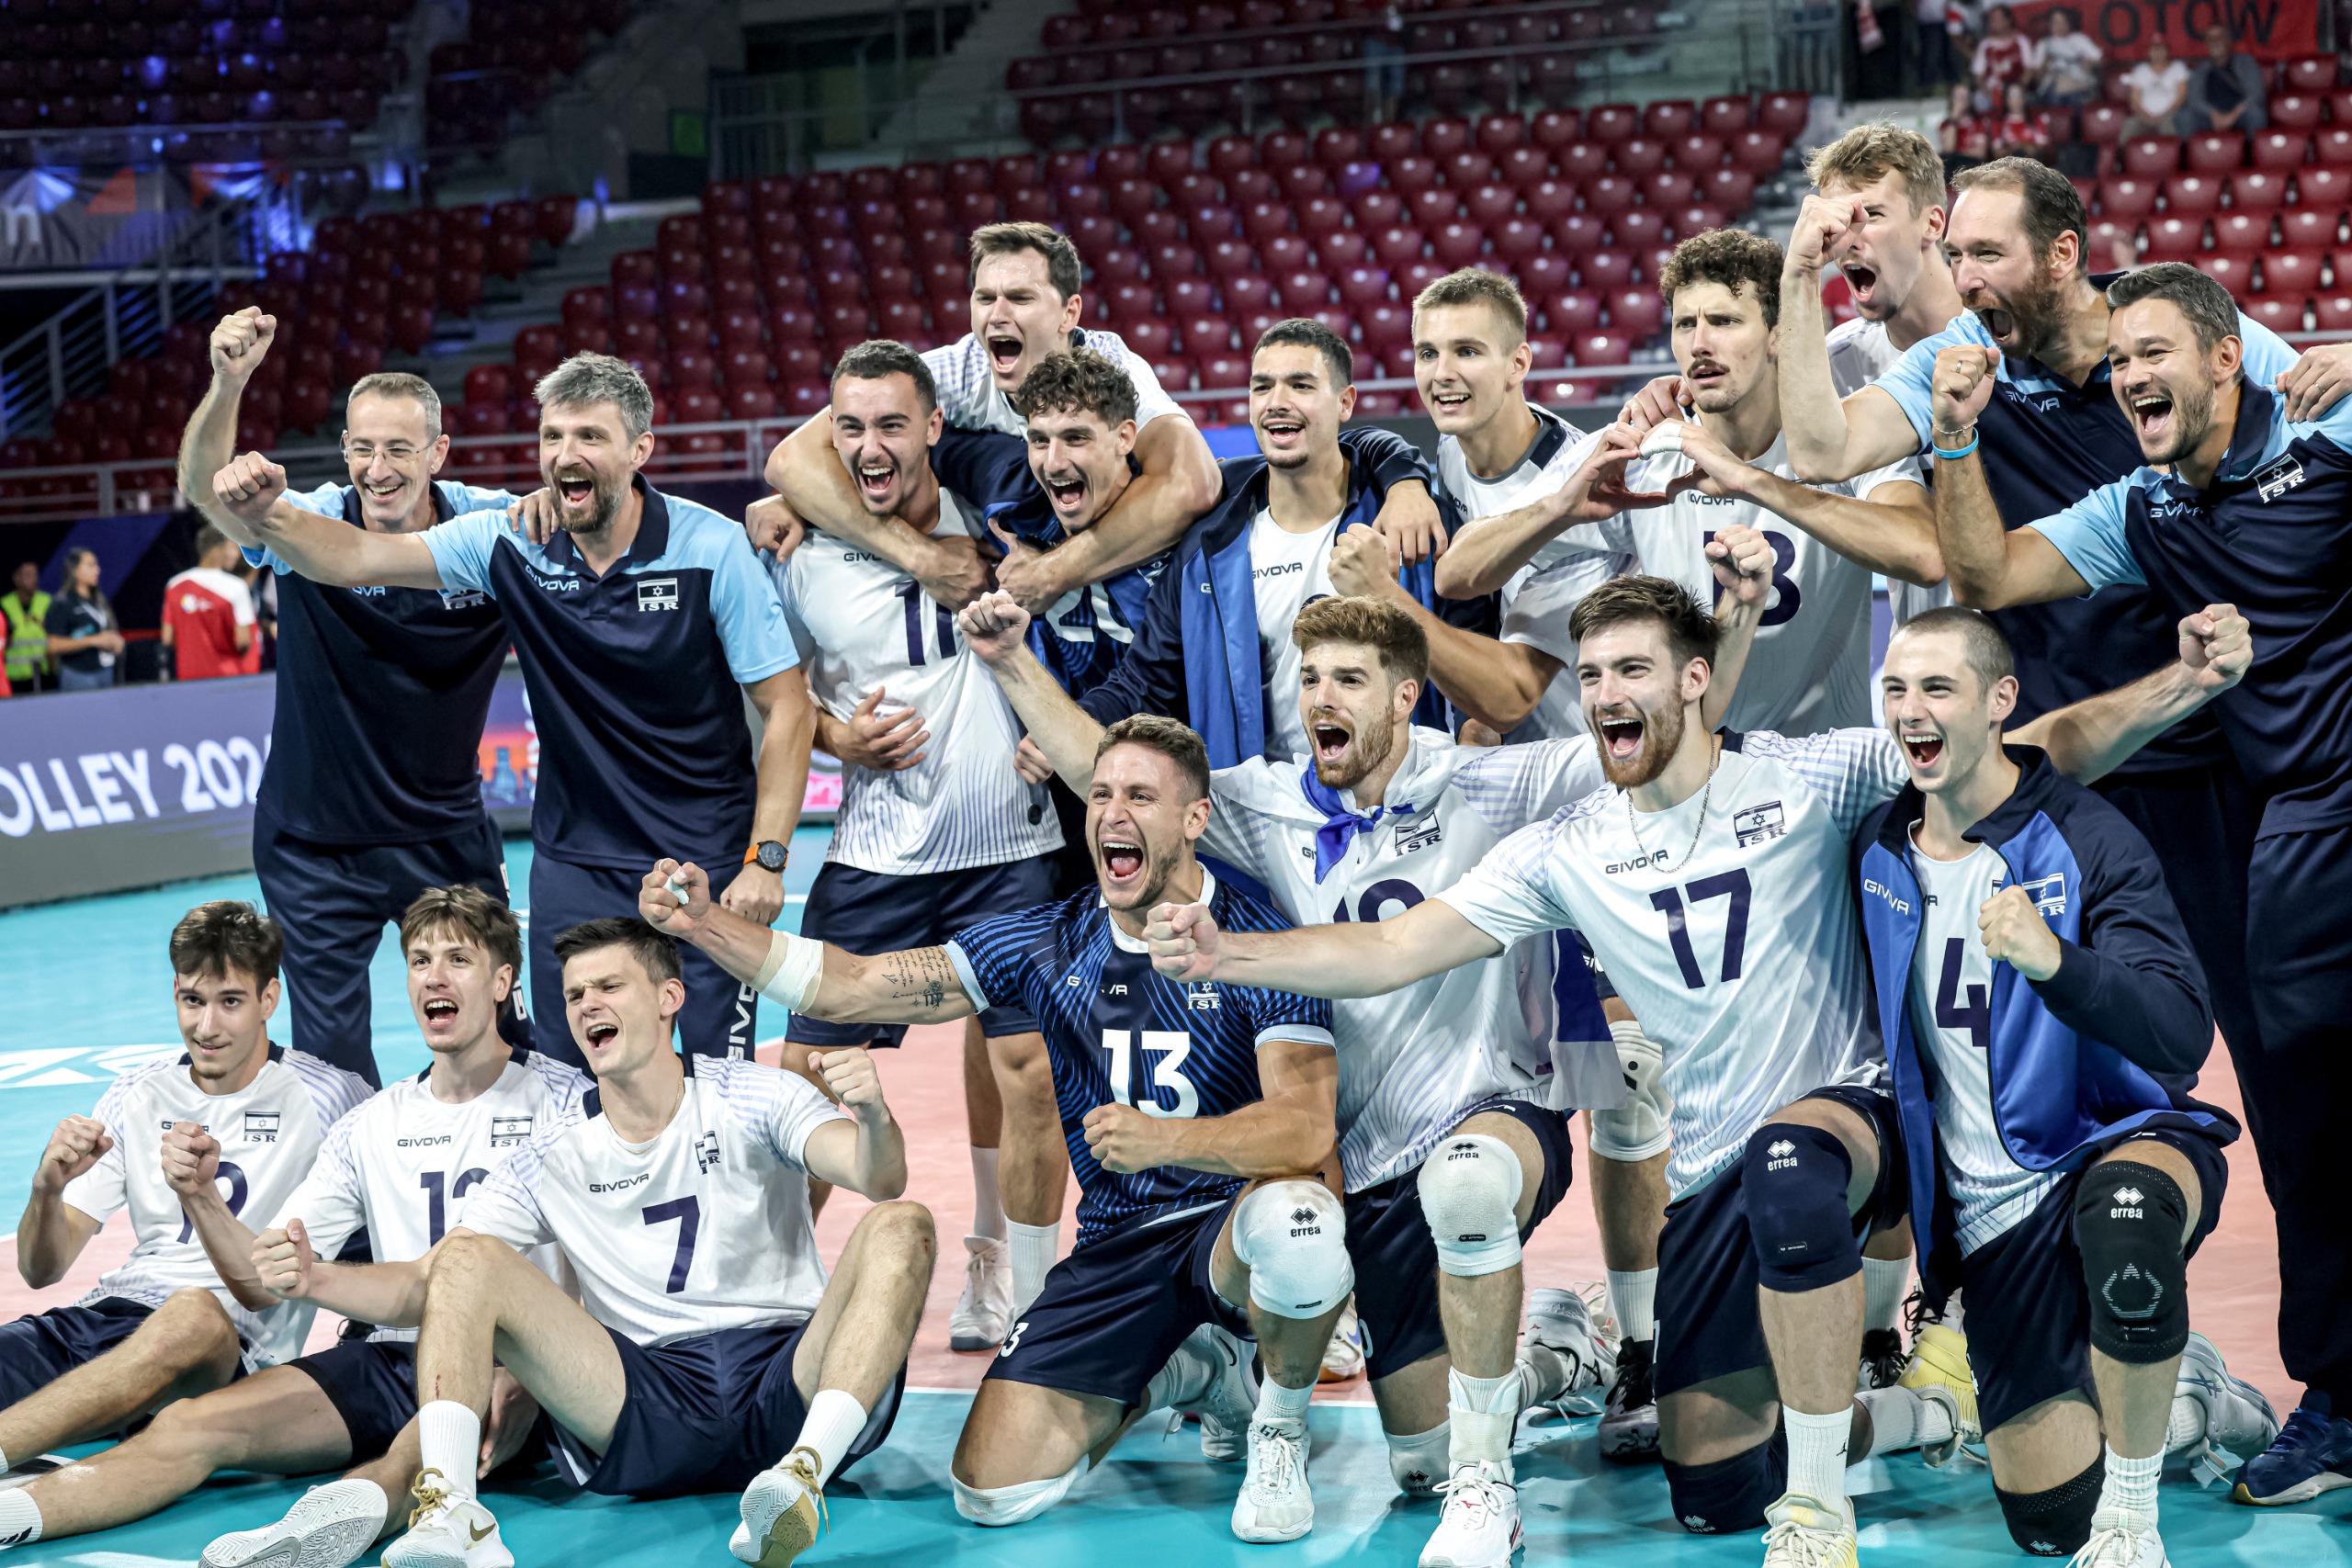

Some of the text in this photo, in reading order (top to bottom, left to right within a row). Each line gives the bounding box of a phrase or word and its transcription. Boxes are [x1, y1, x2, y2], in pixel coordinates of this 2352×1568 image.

[2262, 474, 2307, 503] ISR
[639, 602, 679, 612] ISR
[163, 734, 272, 813] 202
[1396, 833, 1442, 856] ISR
[1738, 828, 1787, 848] ISR
[1605, 850, 1669, 874] GIVOVA
[1649, 867, 1752, 989] 17
[1936, 938, 1989, 1047] 4
[1102, 1029, 1199, 1119] 13
[243, 1134, 277, 1143] ISR
[397, 1135, 452, 1147] GIVOVA
[589, 1173, 650, 1192] GIVOVA
[641, 1194, 701, 1293] 7
